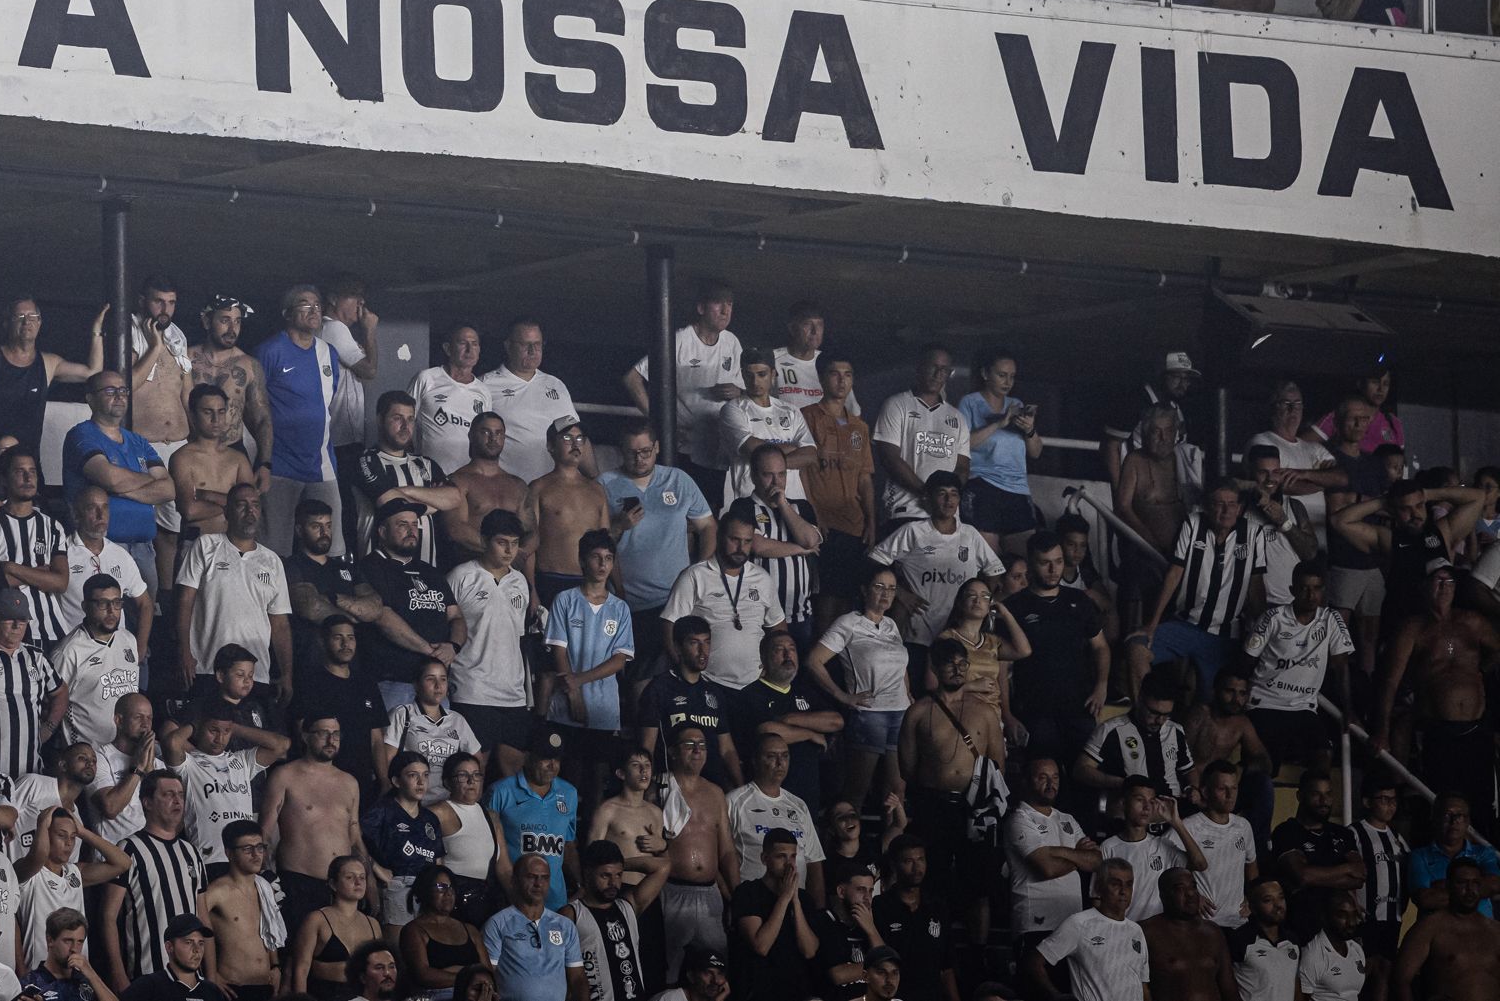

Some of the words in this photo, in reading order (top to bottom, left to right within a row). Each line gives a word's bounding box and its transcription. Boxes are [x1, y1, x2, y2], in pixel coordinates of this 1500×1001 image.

[994, 32, 1454, 211] VIDA
[781, 368, 798, 386] 10
[778, 386, 802, 396] SEMP
[916, 431, 956, 447] Charlie
[921, 568, 967, 587] pixbet
[100, 670, 137, 688] Charlie
[1277, 681, 1316, 695] BINANCE
[520, 823, 548, 832] BANCO
[414, 846, 435, 859] blaze
[521, 833, 564, 857] BMG
